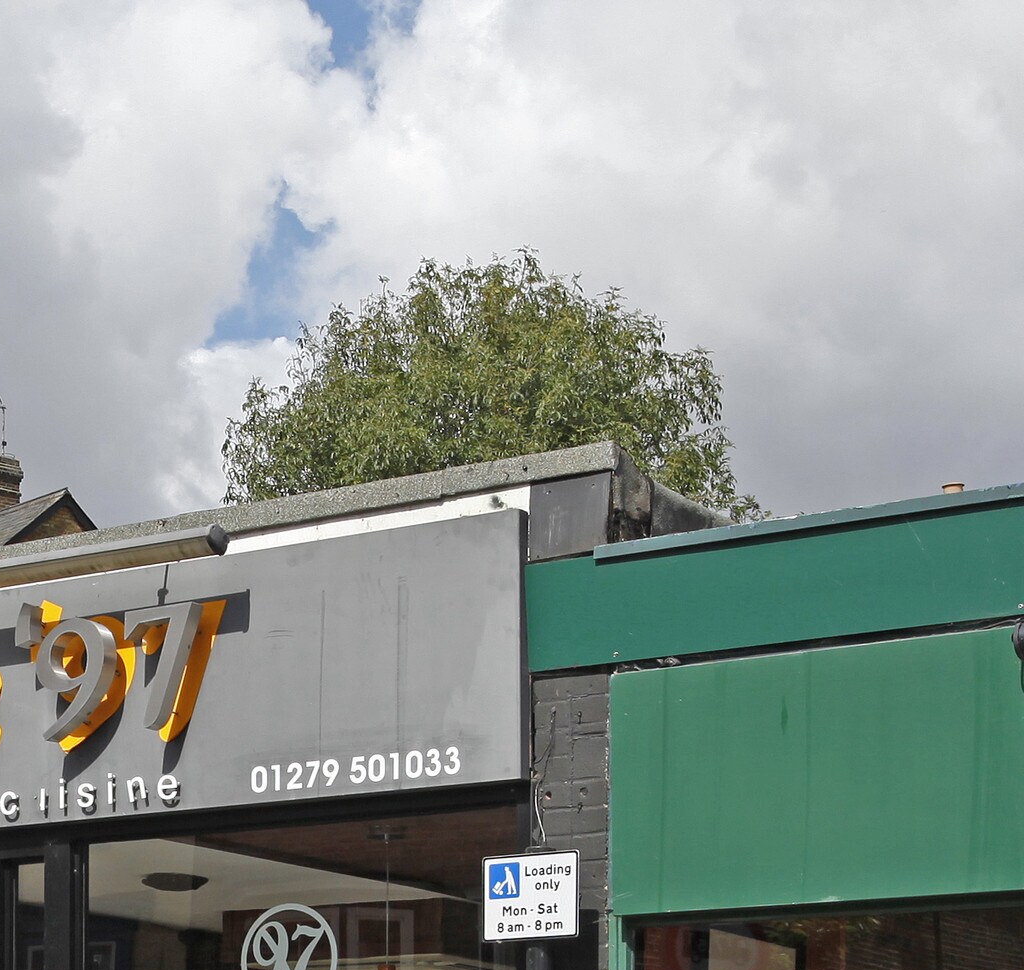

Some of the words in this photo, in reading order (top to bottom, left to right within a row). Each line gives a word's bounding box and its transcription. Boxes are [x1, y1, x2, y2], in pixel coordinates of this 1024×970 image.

[251, 759, 339, 793] 01279
[349, 747, 461, 784] 501033
[525, 864, 571, 877] Loading
[535, 879, 560, 891] only
[502, 905, 527, 917] Mon
[537, 903, 558, 914] Sat
